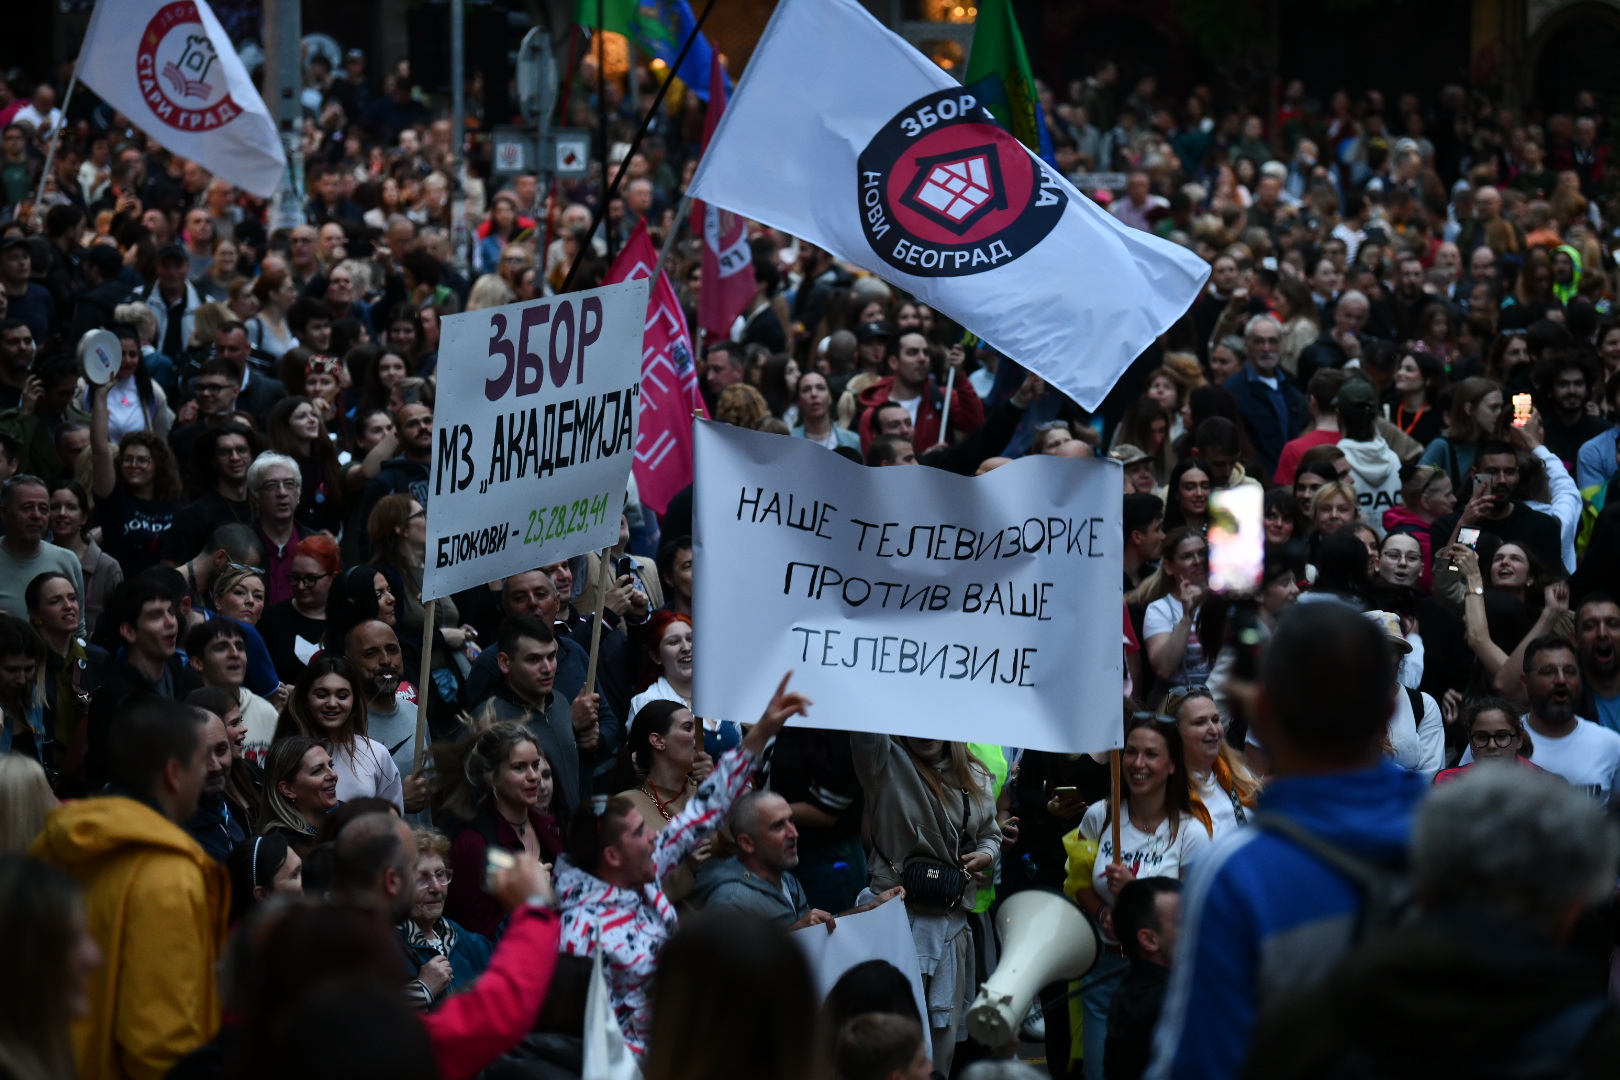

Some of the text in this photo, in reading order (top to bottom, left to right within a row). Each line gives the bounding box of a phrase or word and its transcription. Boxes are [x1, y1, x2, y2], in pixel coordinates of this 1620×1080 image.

[139, 53, 237, 130] СТАРИ ГРАД
[900, 94, 977, 138] ЗБОР
[862, 170, 1013, 269] НОВИ БЕОГРАД
[484, 295, 604, 402] ЗБОР
[435, 423, 475, 496] МЗ
[435, 522, 510, 569] БЛОКОВИ
[523, 492, 609, 548] 25,28,29,41
[737, 486, 1105, 562] НАШЕ ТЕЛЕВИЗОРКЕ
[783, 561, 1055, 621] ПРОТИВ ВАШЕ
[791, 626, 1038, 688] ТЕЛЕВИЗИЈЕ
